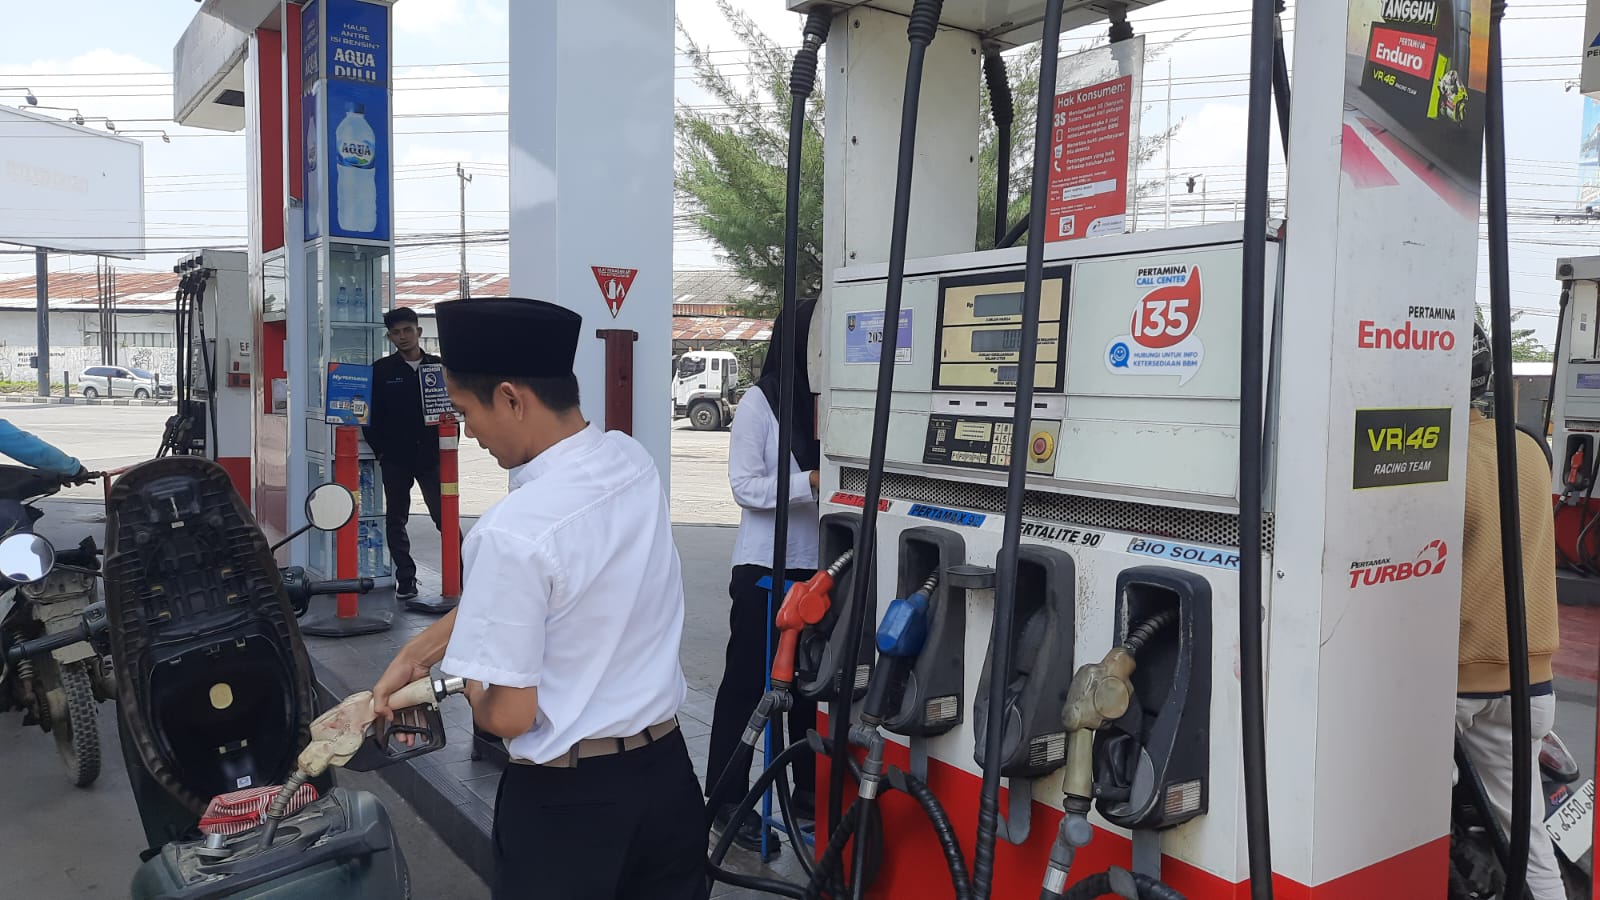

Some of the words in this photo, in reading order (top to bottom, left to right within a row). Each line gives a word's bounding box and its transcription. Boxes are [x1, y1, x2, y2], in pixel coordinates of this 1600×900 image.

[1381, 0, 1436, 22] TANGGUH
[341, 30, 370, 40] ANTRE
[343, 23, 368, 32] HAUS
[331, 35, 341, 43] ISI
[343, 38, 380, 49] BENSIN?
[1399, 37, 1426, 49] PERTAMINA
[334, 48, 376, 67] AQUA
[1376, 42, 1423, 70] Enduro
[1587, 49, 1600, 58] PE
[335, 65, 376, 82] DULU
[1057, 95, 1074, 108] Hak
[1077, 82, 1126, 103] Konsumen:
[1054, 112, 1066, 127] 3S
[342, 142, 372, 157] AQUA
[1138, 265, 1187, 276] PERTAMINA
[1136, 277, 1154, 285] CALL
[1156, 275, 1186, 284] CENTER
[1134, 299, 1189, 337] 135
[1408, 306, 1456, 320] PERTAMINA
[1358, 320, 1455, 351] Enduro
[1373, 462, 1407, 474] RACING
[1408, 461, 1432, 472] TEAM
[913, 504, 966, 525] PERTAMAX
[1020, 523, 1081, 544] ERTALITE
[1081, 532, 1101, 548] 90
[1132, 538, 1165, 555] BIO
[1170, 546, 1240, 568] SOLAR
[1350, 558, 1391, 569] PERTAMAX
[1350, 560, 1432, 589] TURBO
[1558, 798, 1586, 831] 4550
